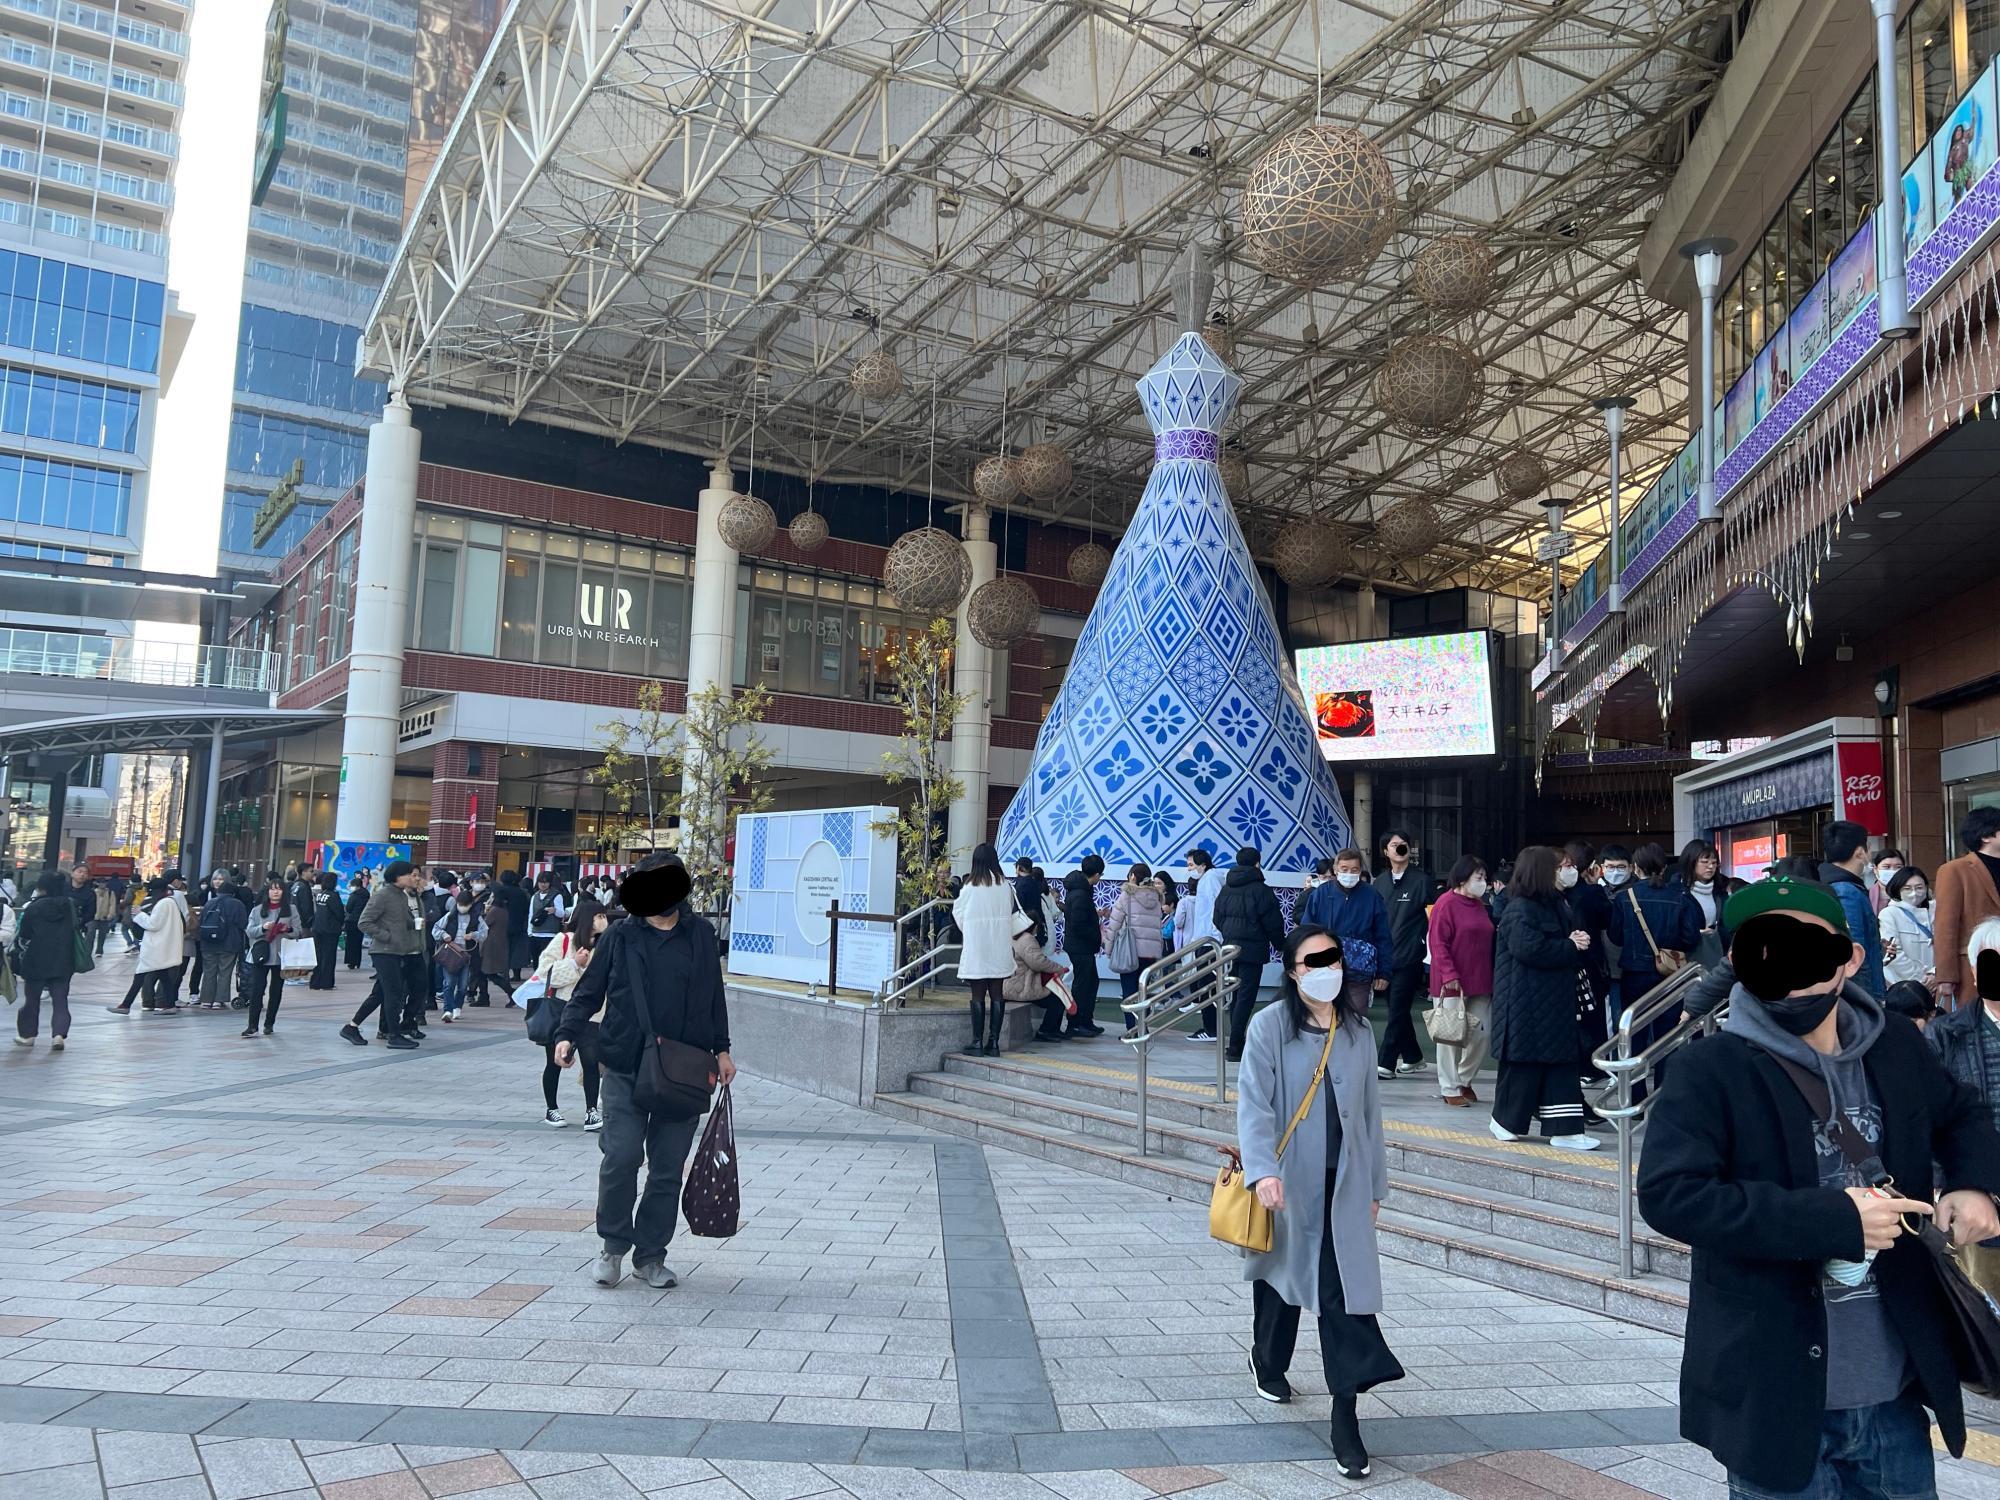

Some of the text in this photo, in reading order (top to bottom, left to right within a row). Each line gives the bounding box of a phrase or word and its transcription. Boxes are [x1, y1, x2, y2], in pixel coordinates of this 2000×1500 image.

[580, 583, 633, 630] UR
[547, 624, 659, 648] URBAN RESEARCH
[787, 616, 854, 641] URBAN
[1387, 703, 1453, 719] 天平キムチ
[1845, 774, 1882, 792] RED
[1742, 784, 1777, 806] AMUPLAZA
[1846, 789, 1882, 806] AMU
